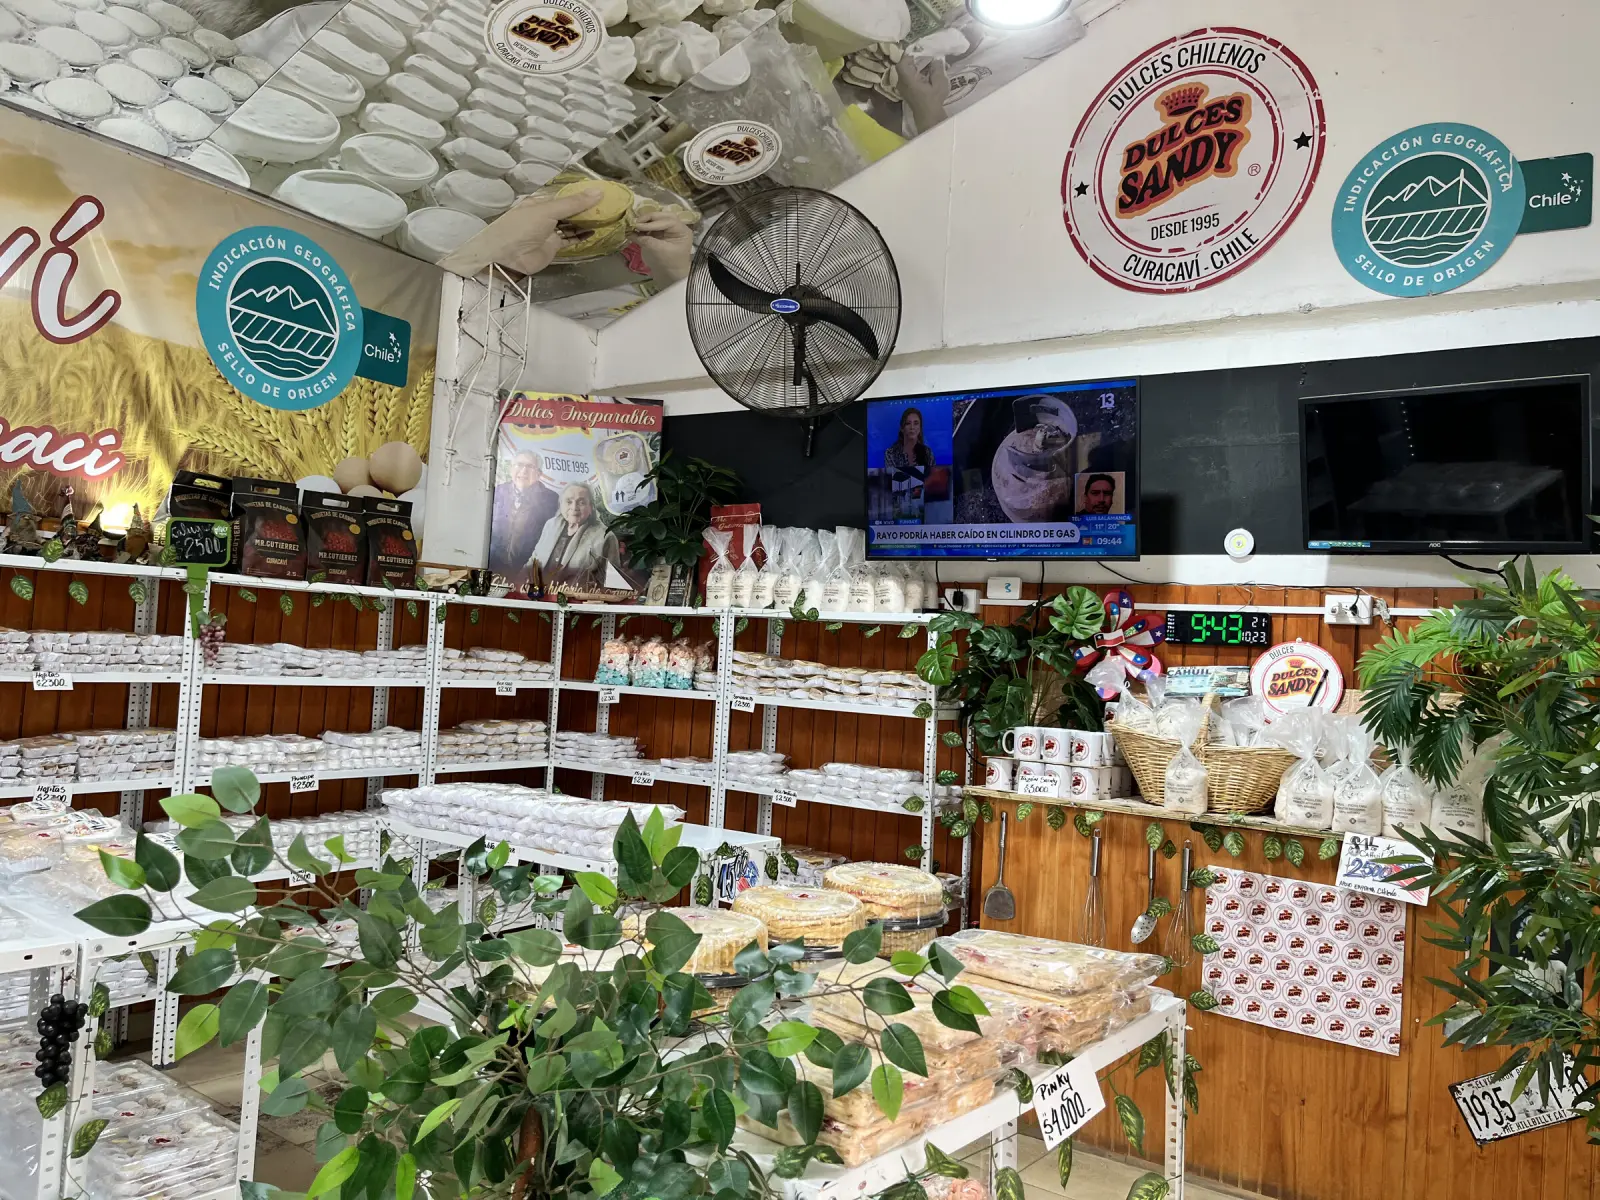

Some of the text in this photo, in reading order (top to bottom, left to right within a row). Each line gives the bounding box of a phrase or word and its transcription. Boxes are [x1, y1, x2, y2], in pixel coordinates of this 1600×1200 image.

[524, 15, 580, 41] DULCES
[572, 6, 596, 34] CHILENOS
[511, 22, 569, 51] SANDY
[522, 61, 542, 71] CHILE
[1108, 42, 1265, 111] DULCES CHILENOS
[1122, 95, 1245, 173] DULCES
[1118, 129, 1245, 214] SANDY
[1343, 132, 1514, 213] INDICACIÓN GEOGRÁFICA
[1528, 192, 1572, 209] Chile
[1151, 212, 1220, 241] DESDE 1995
[1123, 249, 1201, 283] CURACAVÍ
[1210, 228, 1260, 271] CHILE
[1354, 240, 1495, 287] SELLO DE ORIGEN
[208, 234, 356, 332] INDICACIÓN GEOGRÁFICA
[364, 343, 396, 363] Chile
[217, 341, 338, 401] SELLO DE ORIGEN
[1100, 393, 1115, 408] 13
[506, 402, 657, 428] Dulces Inseparables
[545, 456, 590, 474] DESDE 1995
[877, 529, 1076, 540] RAYO PODRÍA HABER CAÍDO EN CILINDRO DE GAS
[1097, 537, 1122, 545] 09:44
[1191, 613, 1243, 644] 9:43
[1269, 645, 1295, 660] DULCES
[1167, 668, 1211, 677] CAHUIL
[1272, 667, 1318, 682] DULCES
[1268, 677, 1316, 697] SANDY
[37, 785, 66, 794] Hojitas
[1462, 1087, 1516, 1132] 1935
[1502, 1109, 1568, 1135] THE HILLBILLY CAT
